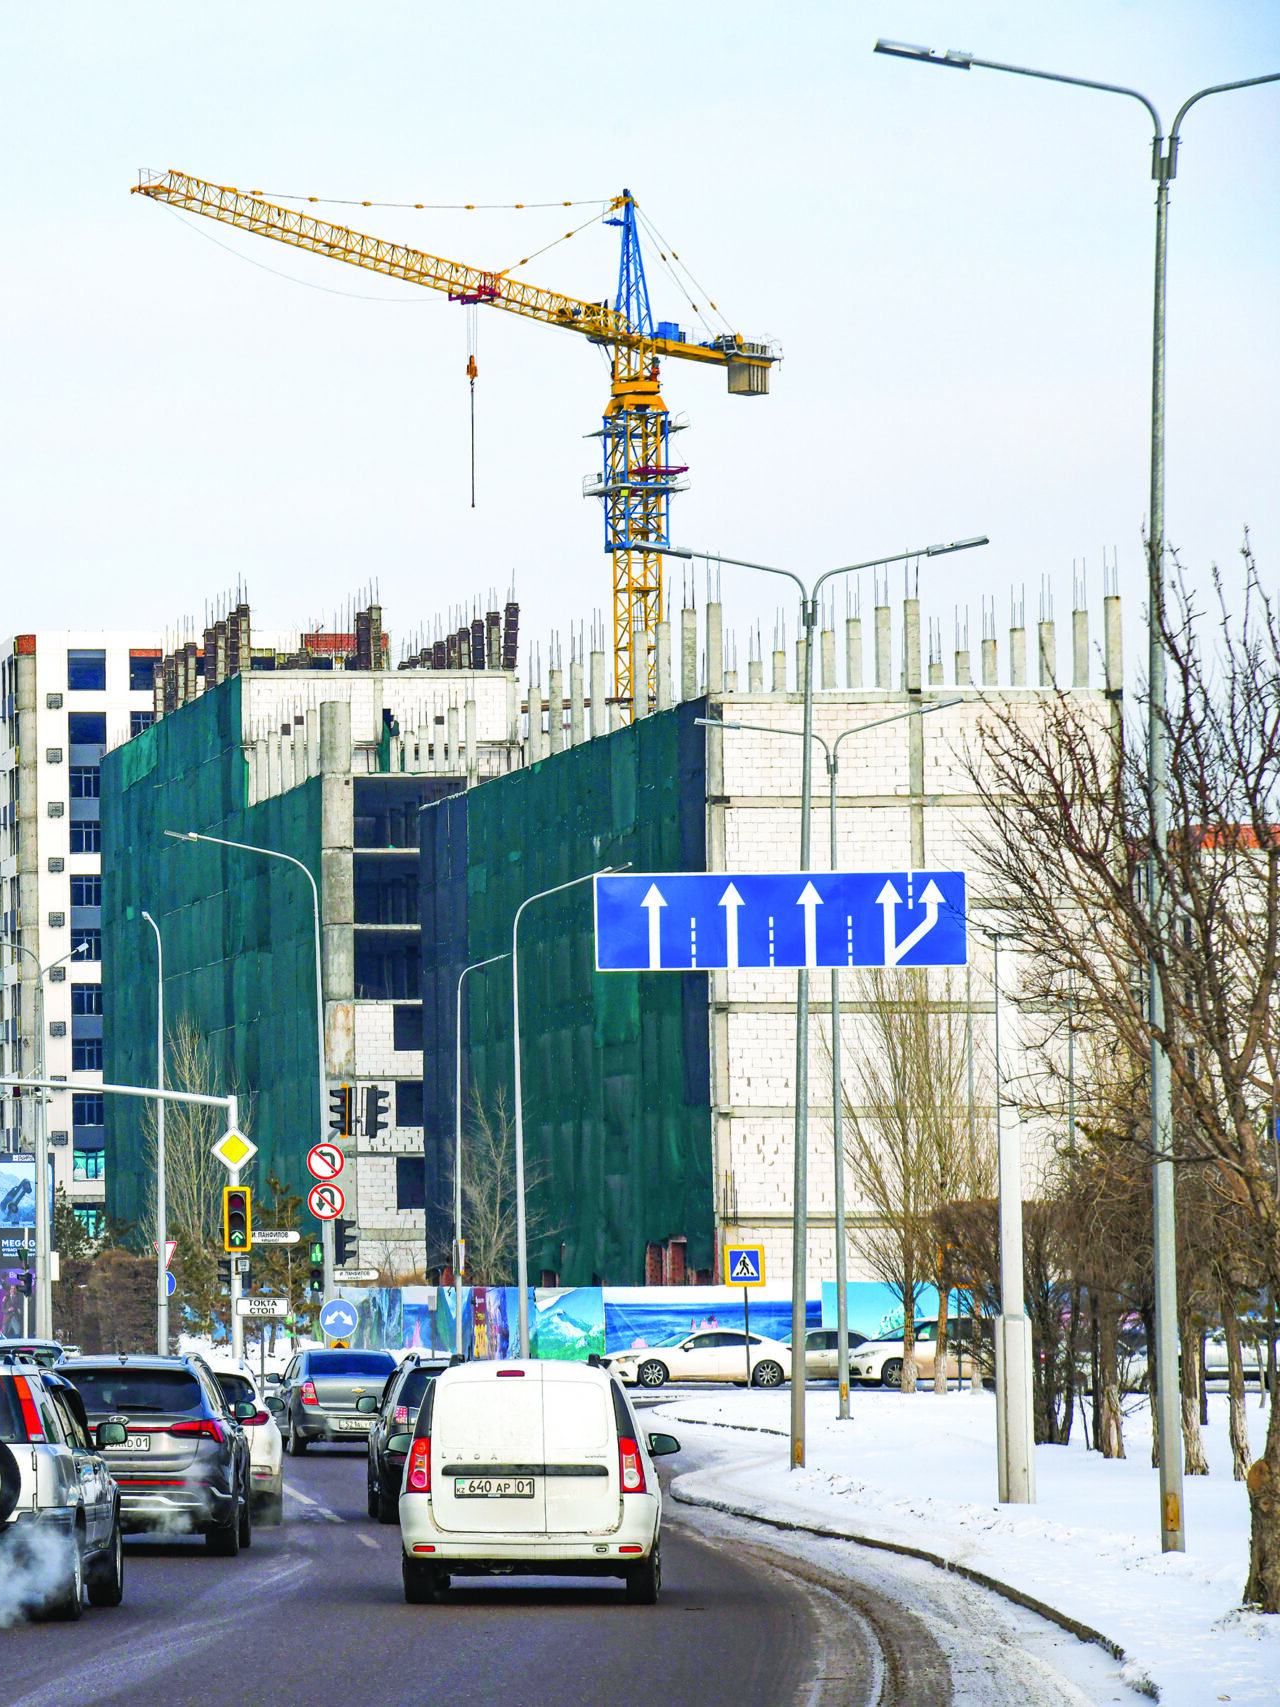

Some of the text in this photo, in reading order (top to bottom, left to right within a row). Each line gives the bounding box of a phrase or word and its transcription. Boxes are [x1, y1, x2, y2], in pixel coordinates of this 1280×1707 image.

[1, 1239, 36, 1247] MEGG
[249, 1307, 275, 1315] СТОП
[135, 1437, 148, 1448] 01
[468, 1480, 492, 1493] 640
[495, 1483, 511, 1493] AP
[516, 1480, 533, 1494] 01
